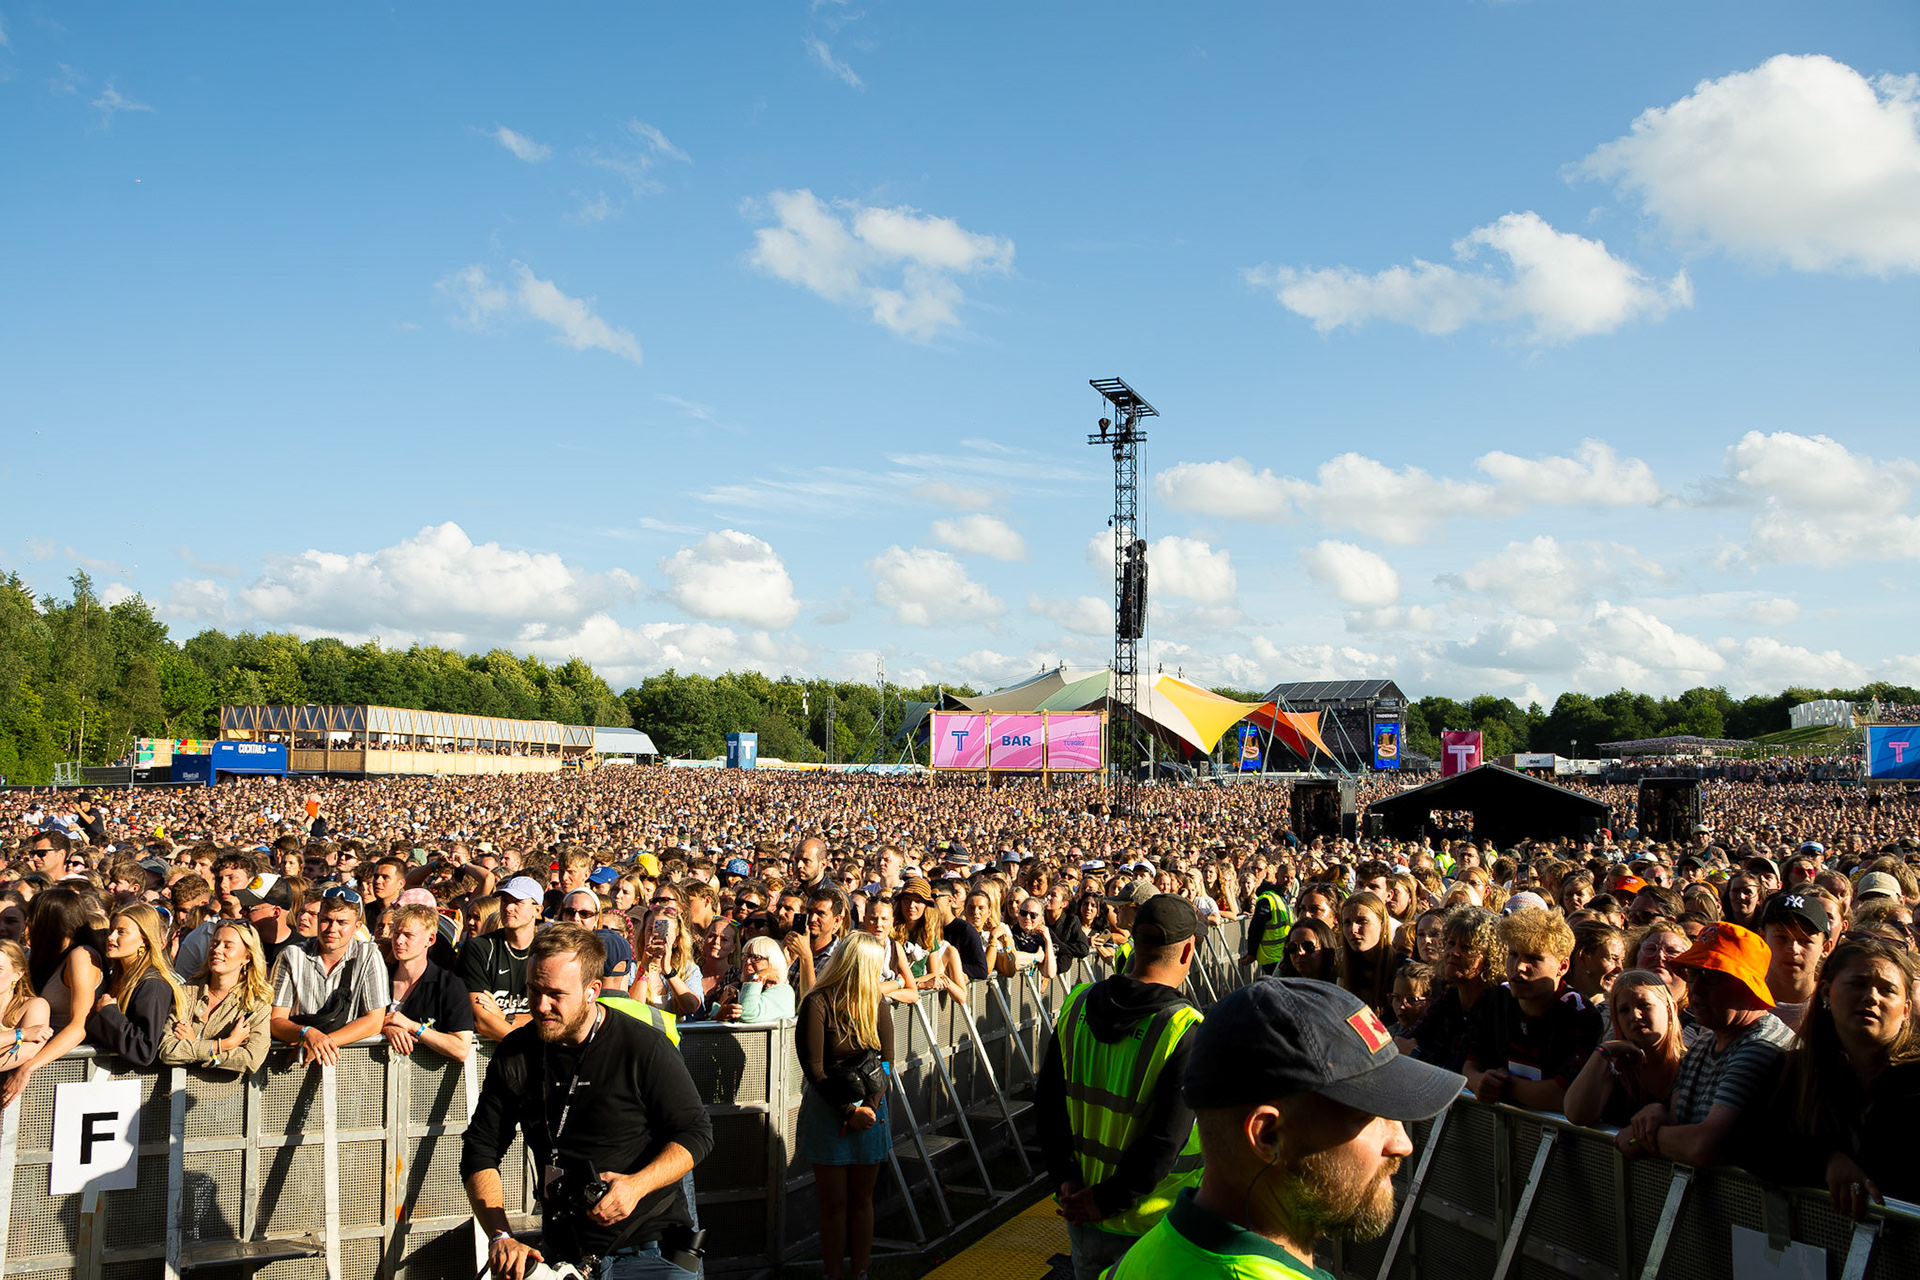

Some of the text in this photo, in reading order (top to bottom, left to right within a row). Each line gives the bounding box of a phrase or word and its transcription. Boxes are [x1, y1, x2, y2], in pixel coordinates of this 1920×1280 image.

[1788, 699, 1856, 729] TINDERBOX
[238, 743, 267, 755] COCKTAILS
[728, 741, 737, 759] T
[741, 741, 755, 759] T
[952, 731, 969, 751] T
[1002, 735, 1032, 747] BAR
[1447, 745, 1475, 773] T
[1888, 742, 1909, 763] T
[1784, 895, 1805, 908] NY
[80, 1111, 119, 1165] F
